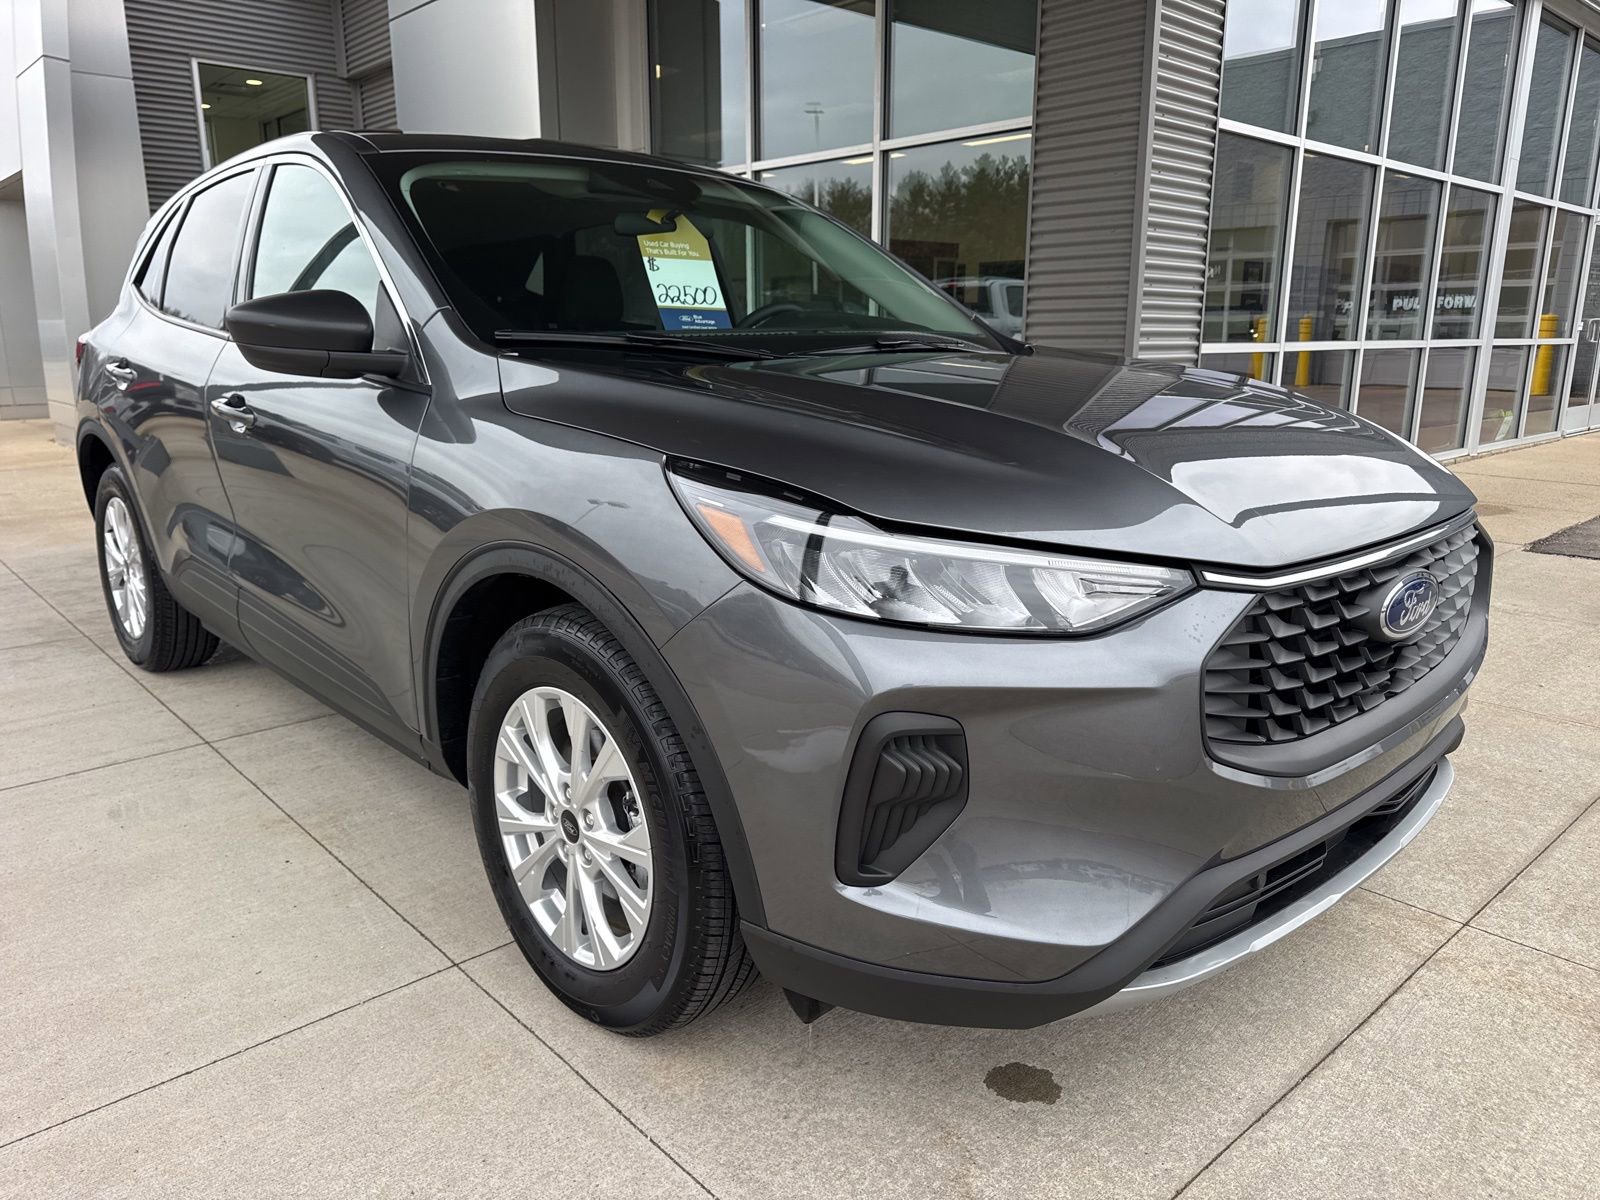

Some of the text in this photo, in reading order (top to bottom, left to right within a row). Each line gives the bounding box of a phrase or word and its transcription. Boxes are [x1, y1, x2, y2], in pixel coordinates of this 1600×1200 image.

[670, 241, 690, 250] Buying
[647, 256, 660, 271] $
[1399, 583, 1432, 626] Ford
